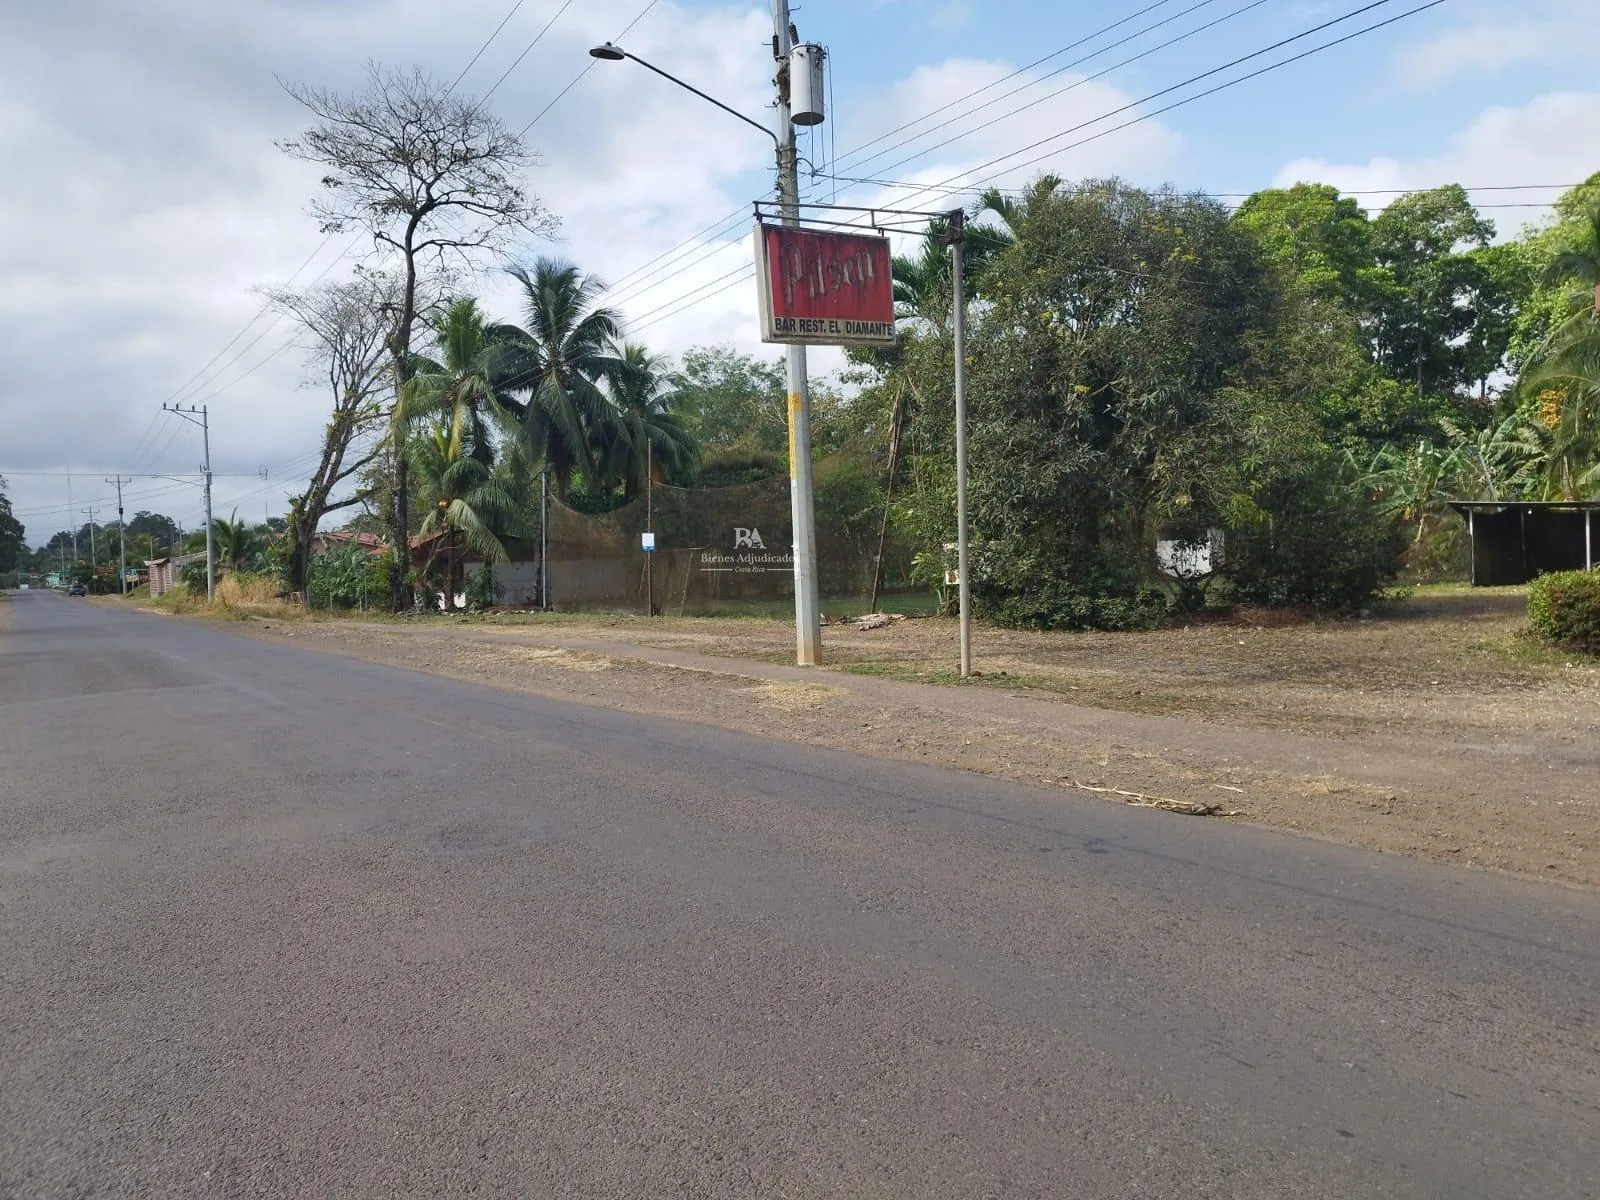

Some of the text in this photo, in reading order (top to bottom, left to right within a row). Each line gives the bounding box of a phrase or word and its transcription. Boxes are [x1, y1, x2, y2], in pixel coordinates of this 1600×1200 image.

[775, 318, 893, 336] BAR REST. EL DIAMANTE
